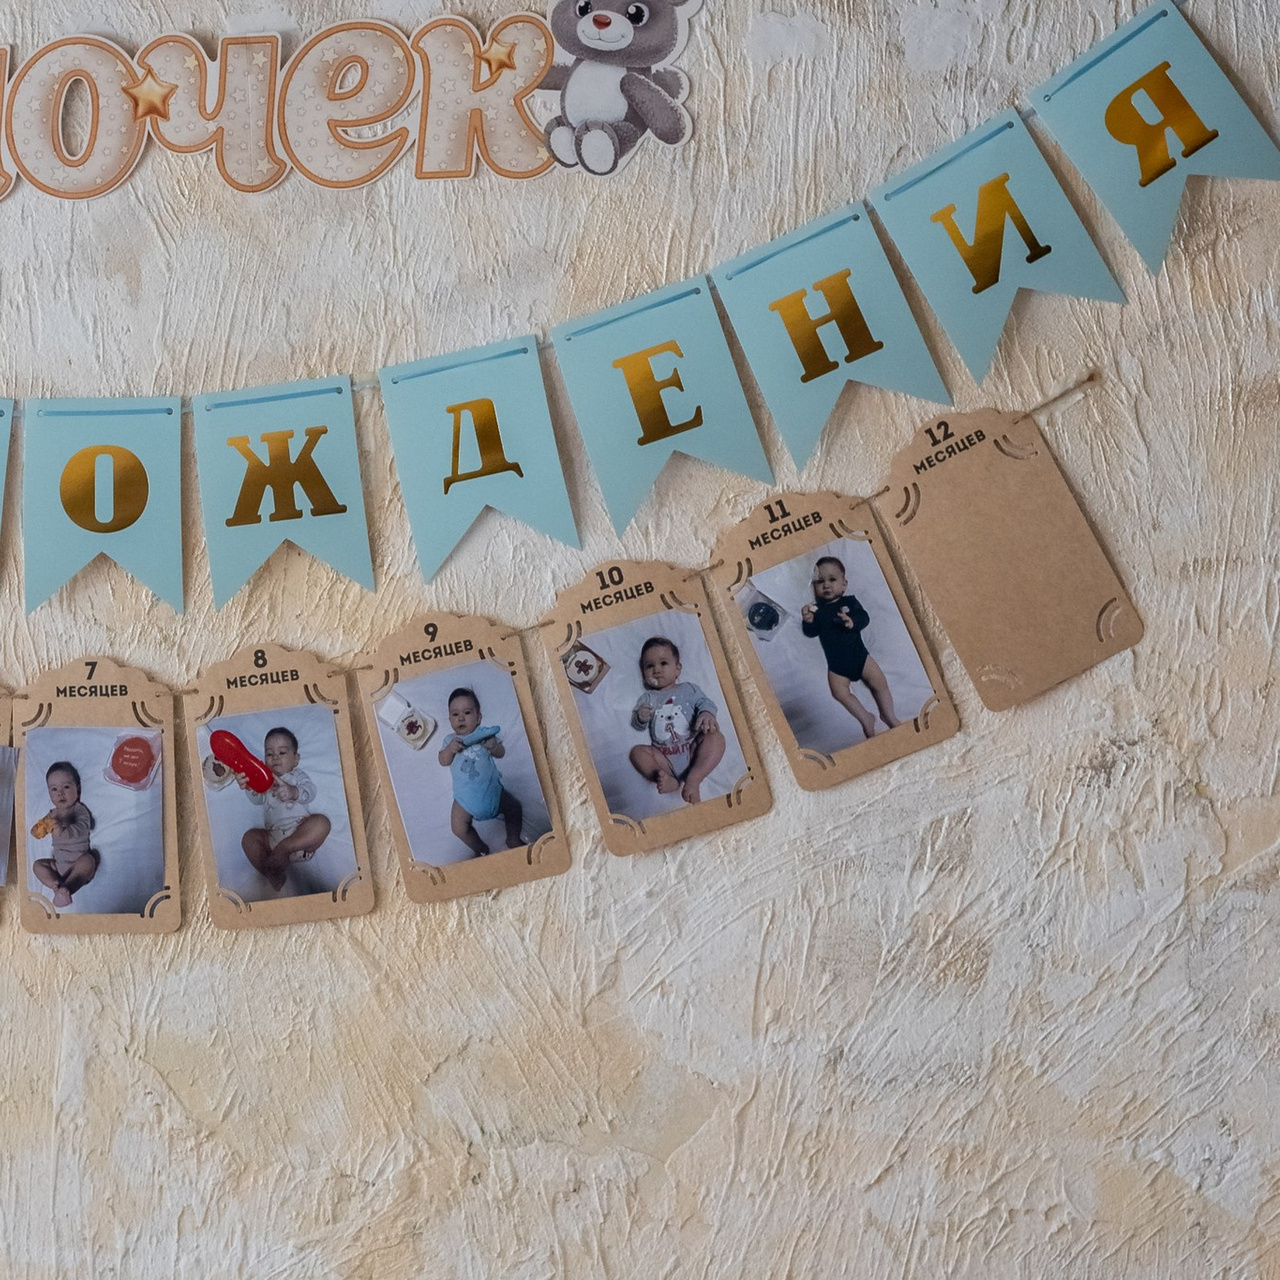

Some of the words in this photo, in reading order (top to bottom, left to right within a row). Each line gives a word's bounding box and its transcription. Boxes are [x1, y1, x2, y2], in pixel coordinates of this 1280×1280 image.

[924, 420, 955, 447] 12
[912, 429, 987, 475] МЕСЯЦЕВ
[763, 499, 791, 524] 11
[748, 511, 823, 550] МЕСЯЦЕВ
[595, 566, 624, 591] 10
[580, 581, 655, 614] МЕСЯЦЕВ
[423, 623, 438, 642] 9
[254, 649, 268, 668] 8
[399, 639, 474, 666] МЕСЯЦЕВ
[85, 661, 98, 680] 7
[226, 669, 300, 689] МЕСЯЦЕВ
[56, 684, 128, 699] МЕСЯЦЕВ
